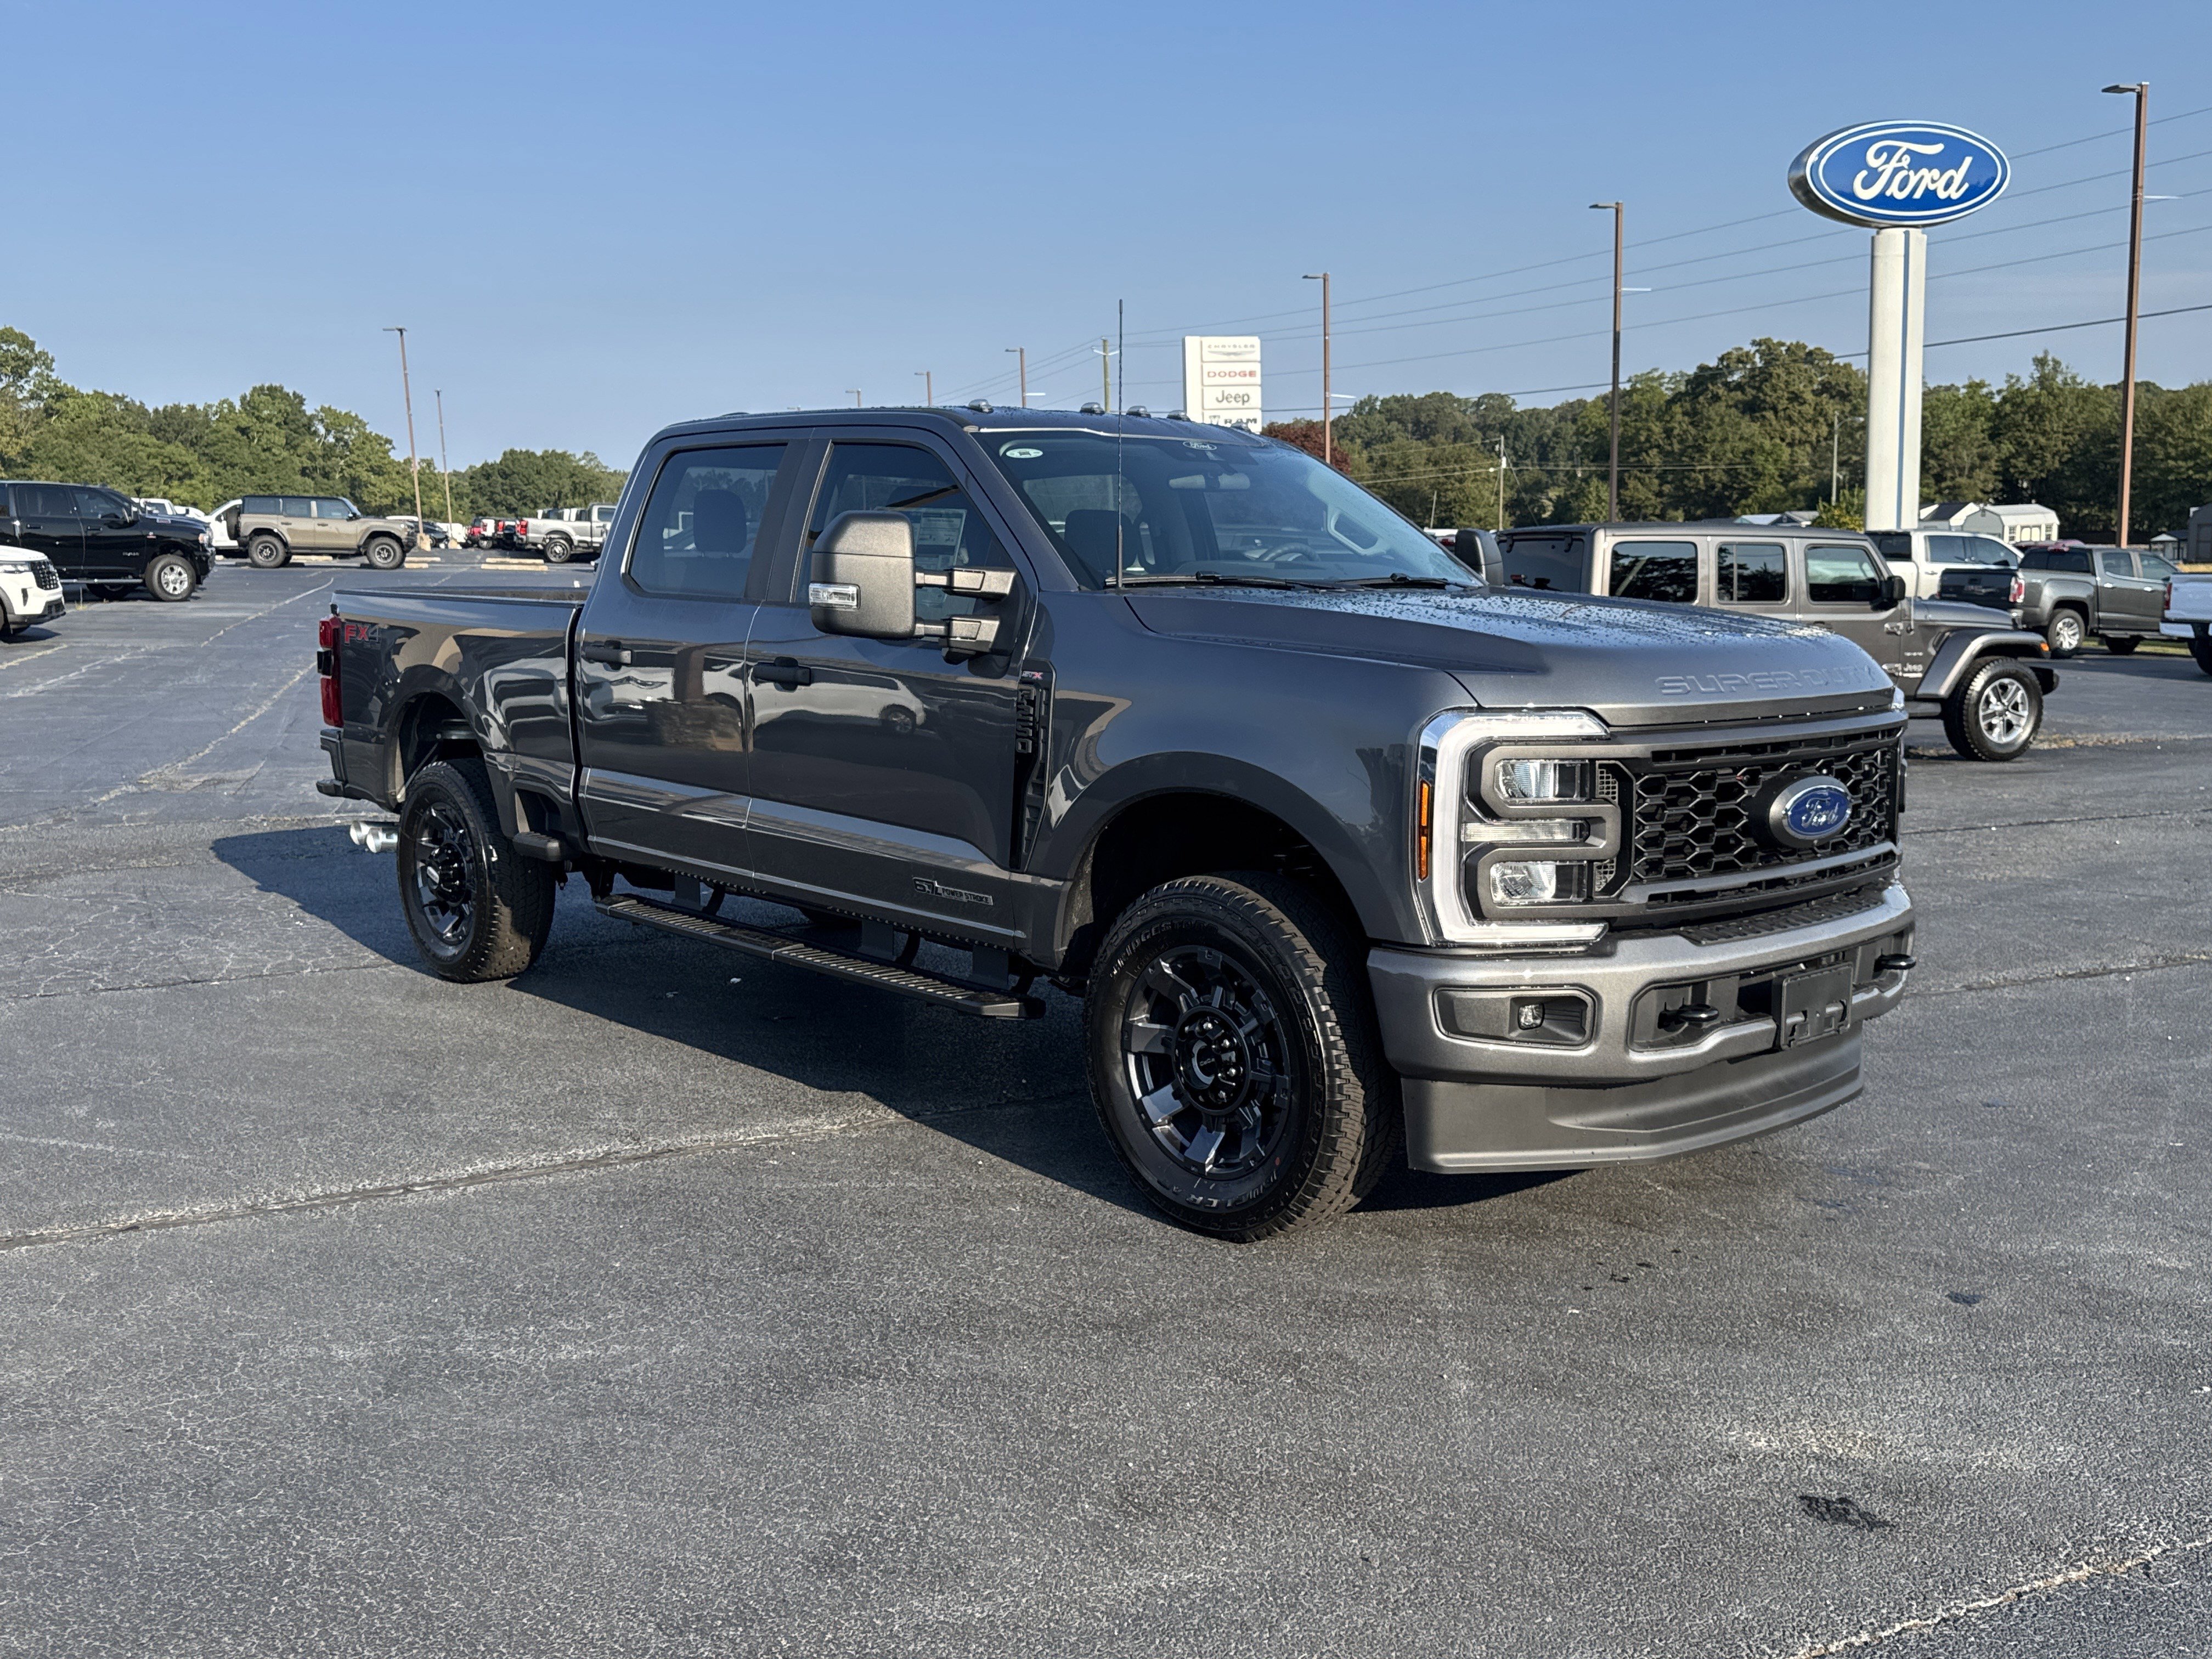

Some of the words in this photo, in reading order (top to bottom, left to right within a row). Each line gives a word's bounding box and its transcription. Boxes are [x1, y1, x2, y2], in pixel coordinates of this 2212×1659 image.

[1853, 140, 1973, 200] Ford
[1216, 390, 1250, 406] Jeep
[345, 624, 379, 643] FX4
[1655, 670, 1802, 695] SUPER
[1801, 797, 1839, 828] Ford
